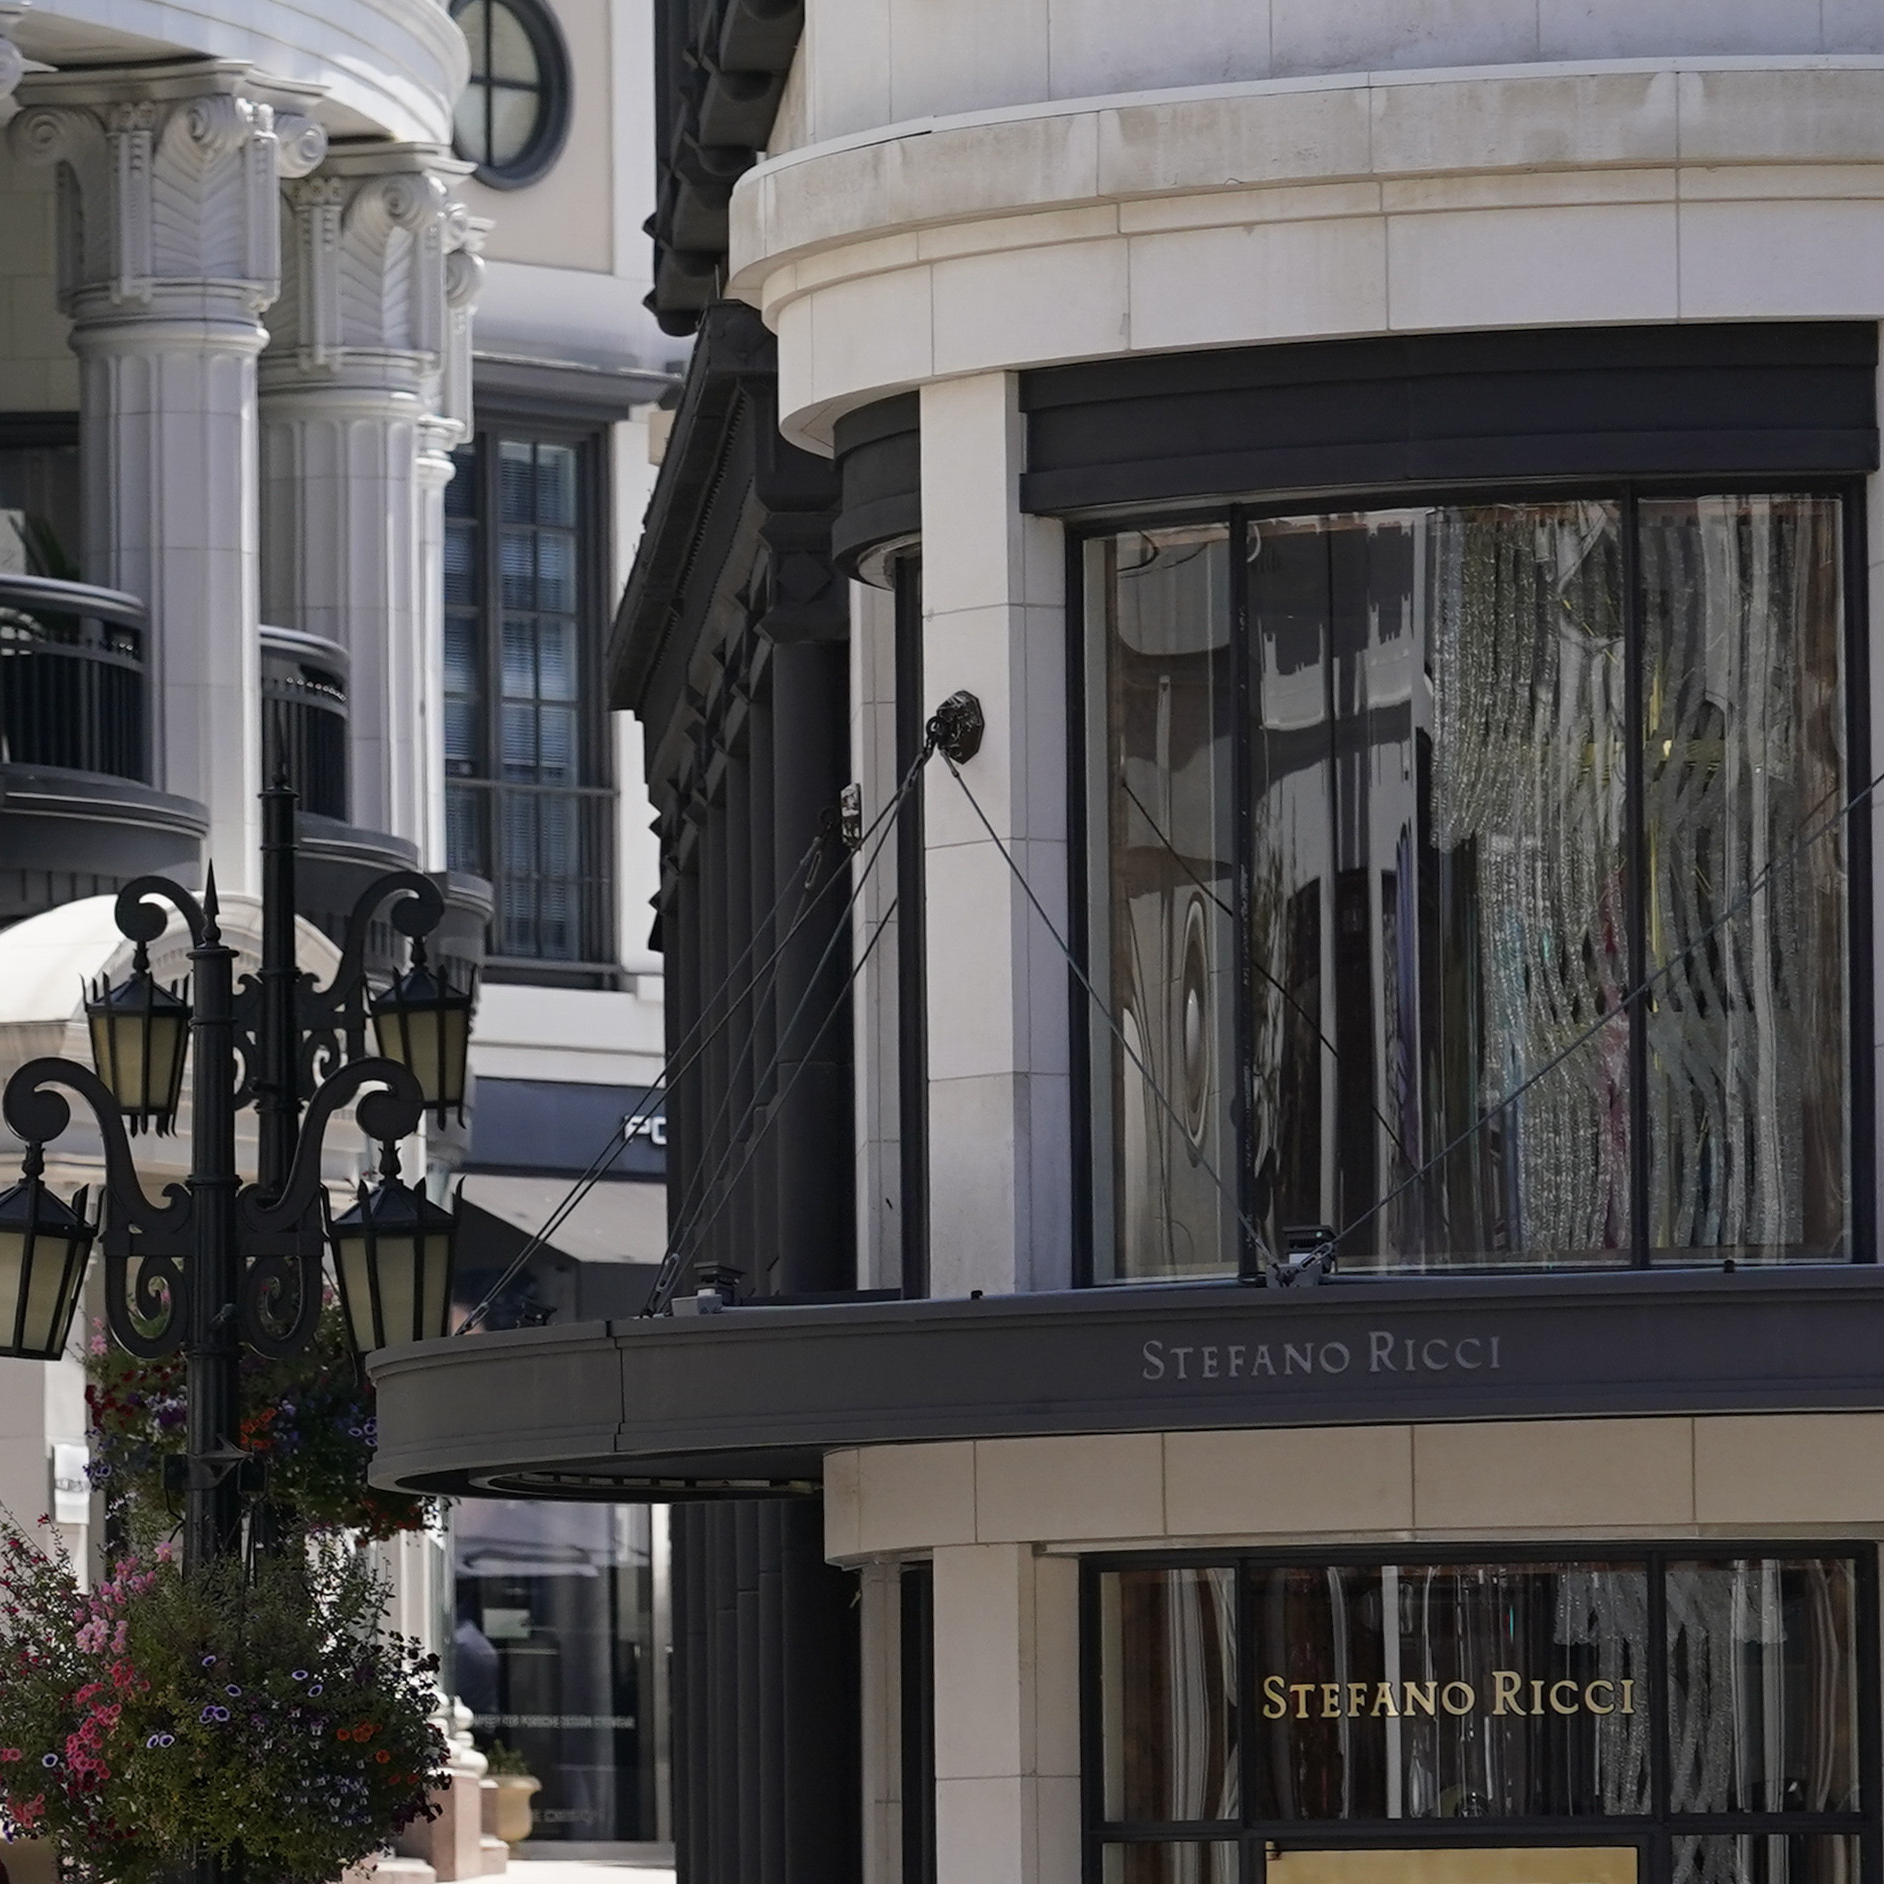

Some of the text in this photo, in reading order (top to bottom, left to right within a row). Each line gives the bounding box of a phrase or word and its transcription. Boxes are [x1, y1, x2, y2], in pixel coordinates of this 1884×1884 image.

[1141, 1330, 1502, 1381] STEFANO RICCI
[1261, 1670, 1639, 1720] STEFANO RICCI
